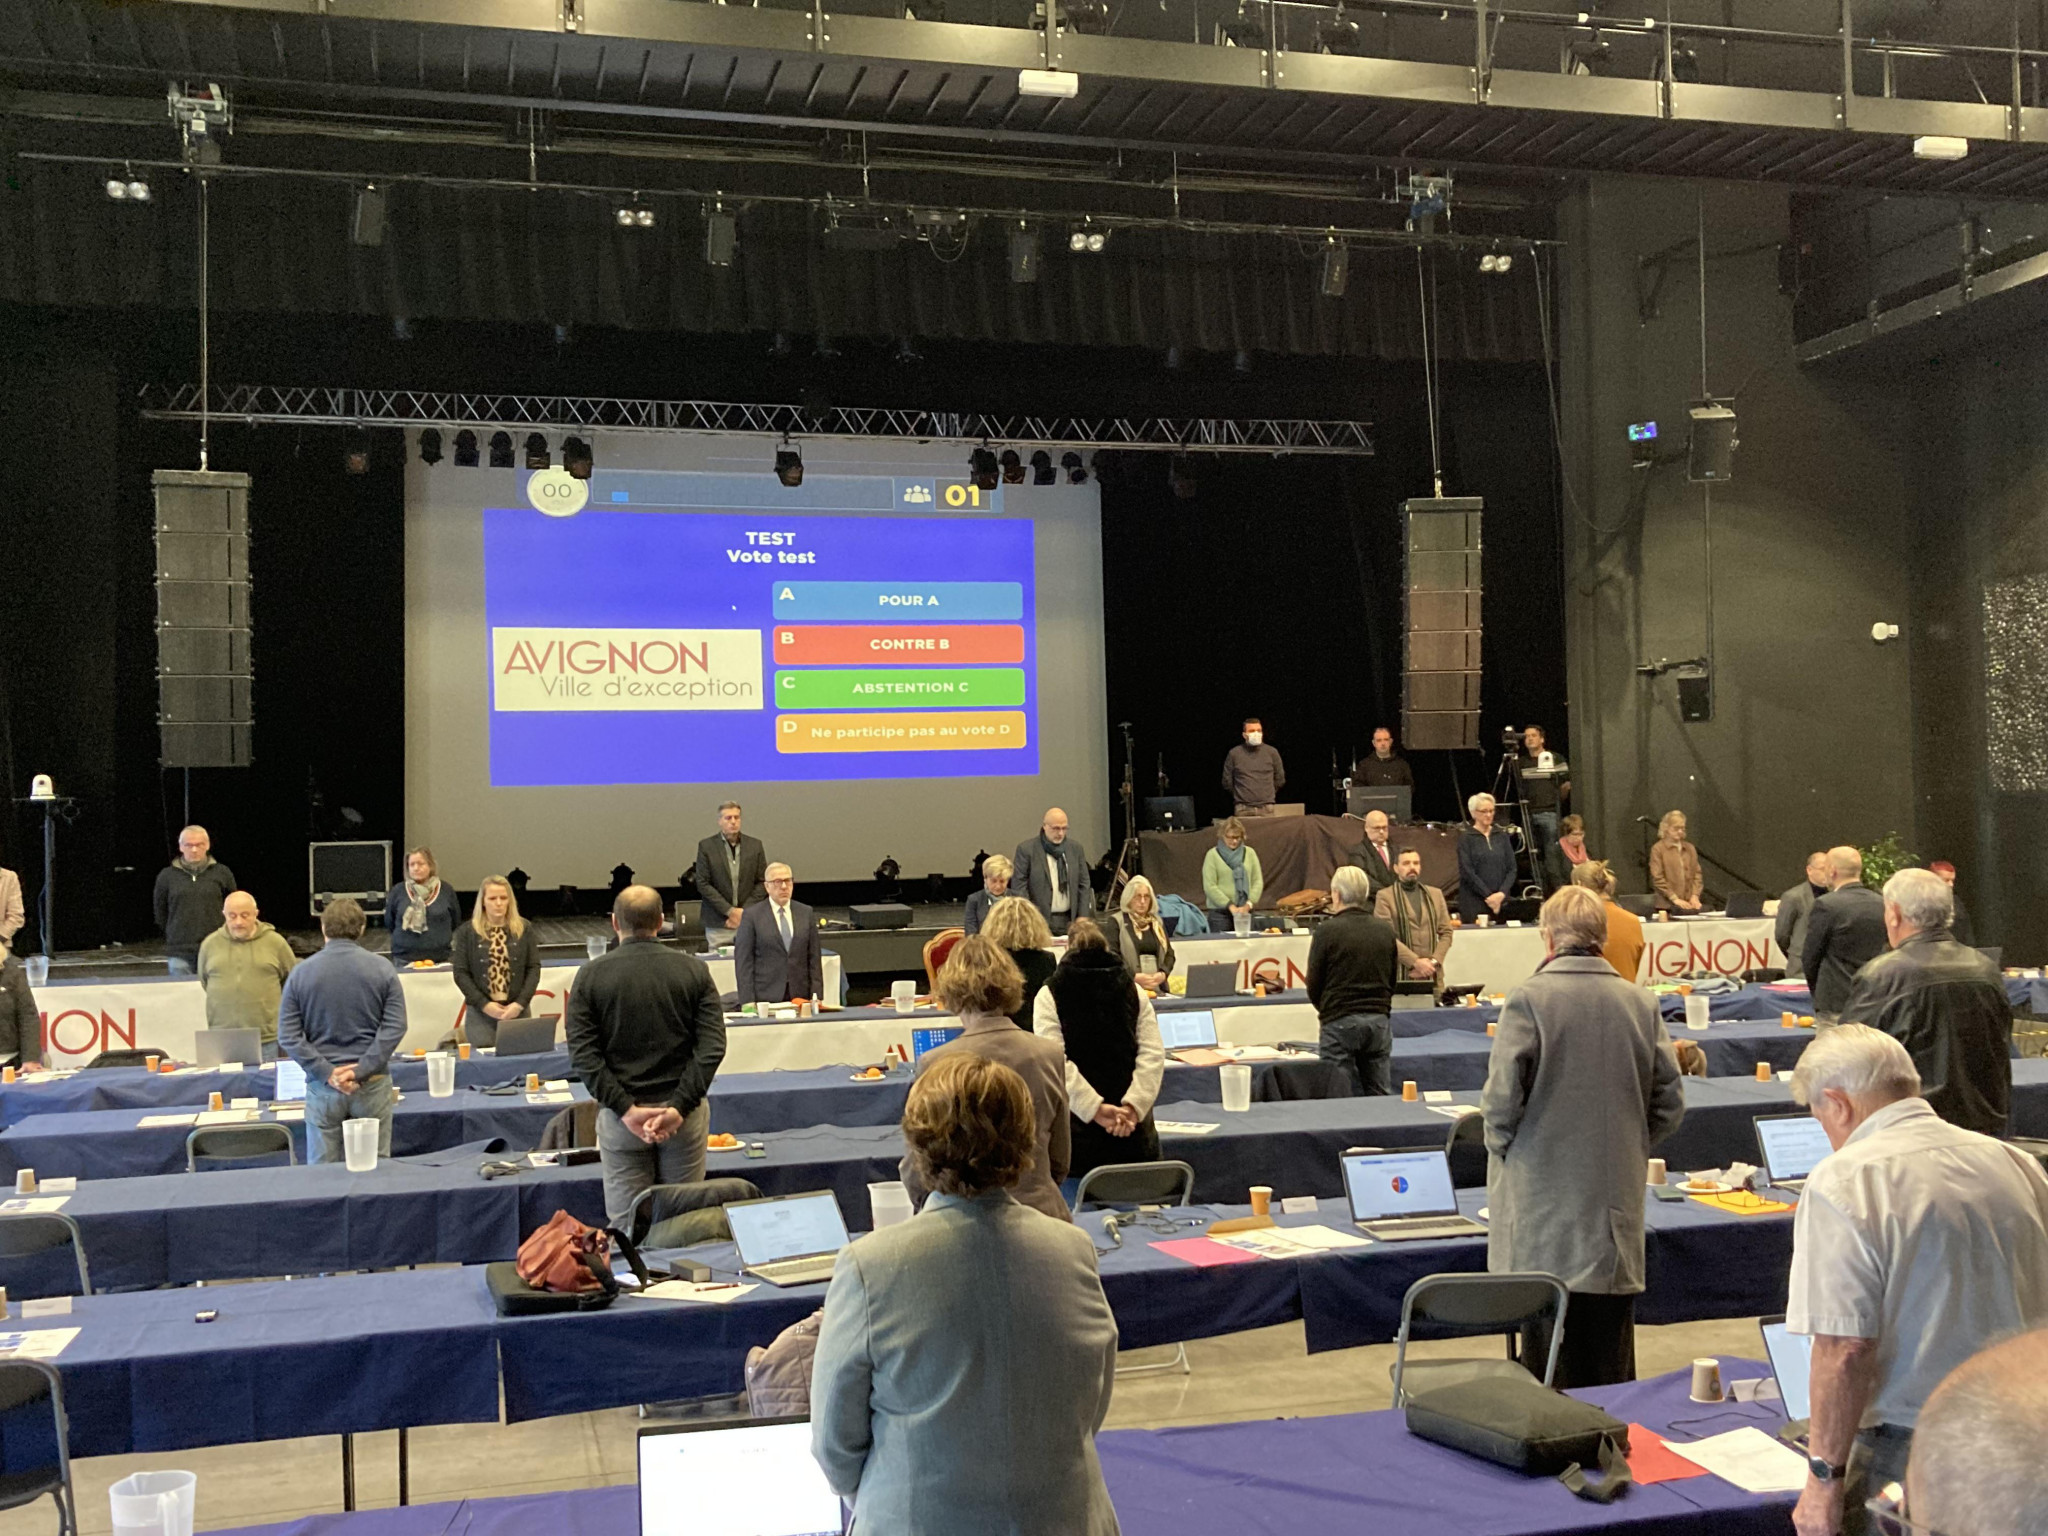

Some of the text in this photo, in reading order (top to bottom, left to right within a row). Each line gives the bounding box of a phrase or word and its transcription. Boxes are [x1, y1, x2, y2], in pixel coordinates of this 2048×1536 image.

[945, 484, 980, 507] 01
[745, 531, 796, 546] TEST
[726, 549, 816, 564] Vote test
[779, 587, 796, 601] A
[879, 595, 940, 606] POUR A
[781, 632, 795, 644] B
[870, 639, 950, 650] CONTRE B
[503, 640, 709, 675] AVIGNON
[540, 675, 753, 701] Ville d'exception
[782, 677, 796, 689] C
[852, 682, 969, 694] ABSTENTION C
[782, 720, 798, 733] D
[811, 723, 1011, 740] Ne participe pas au vote D
[1644, 937, 1770, 977] IGNON
